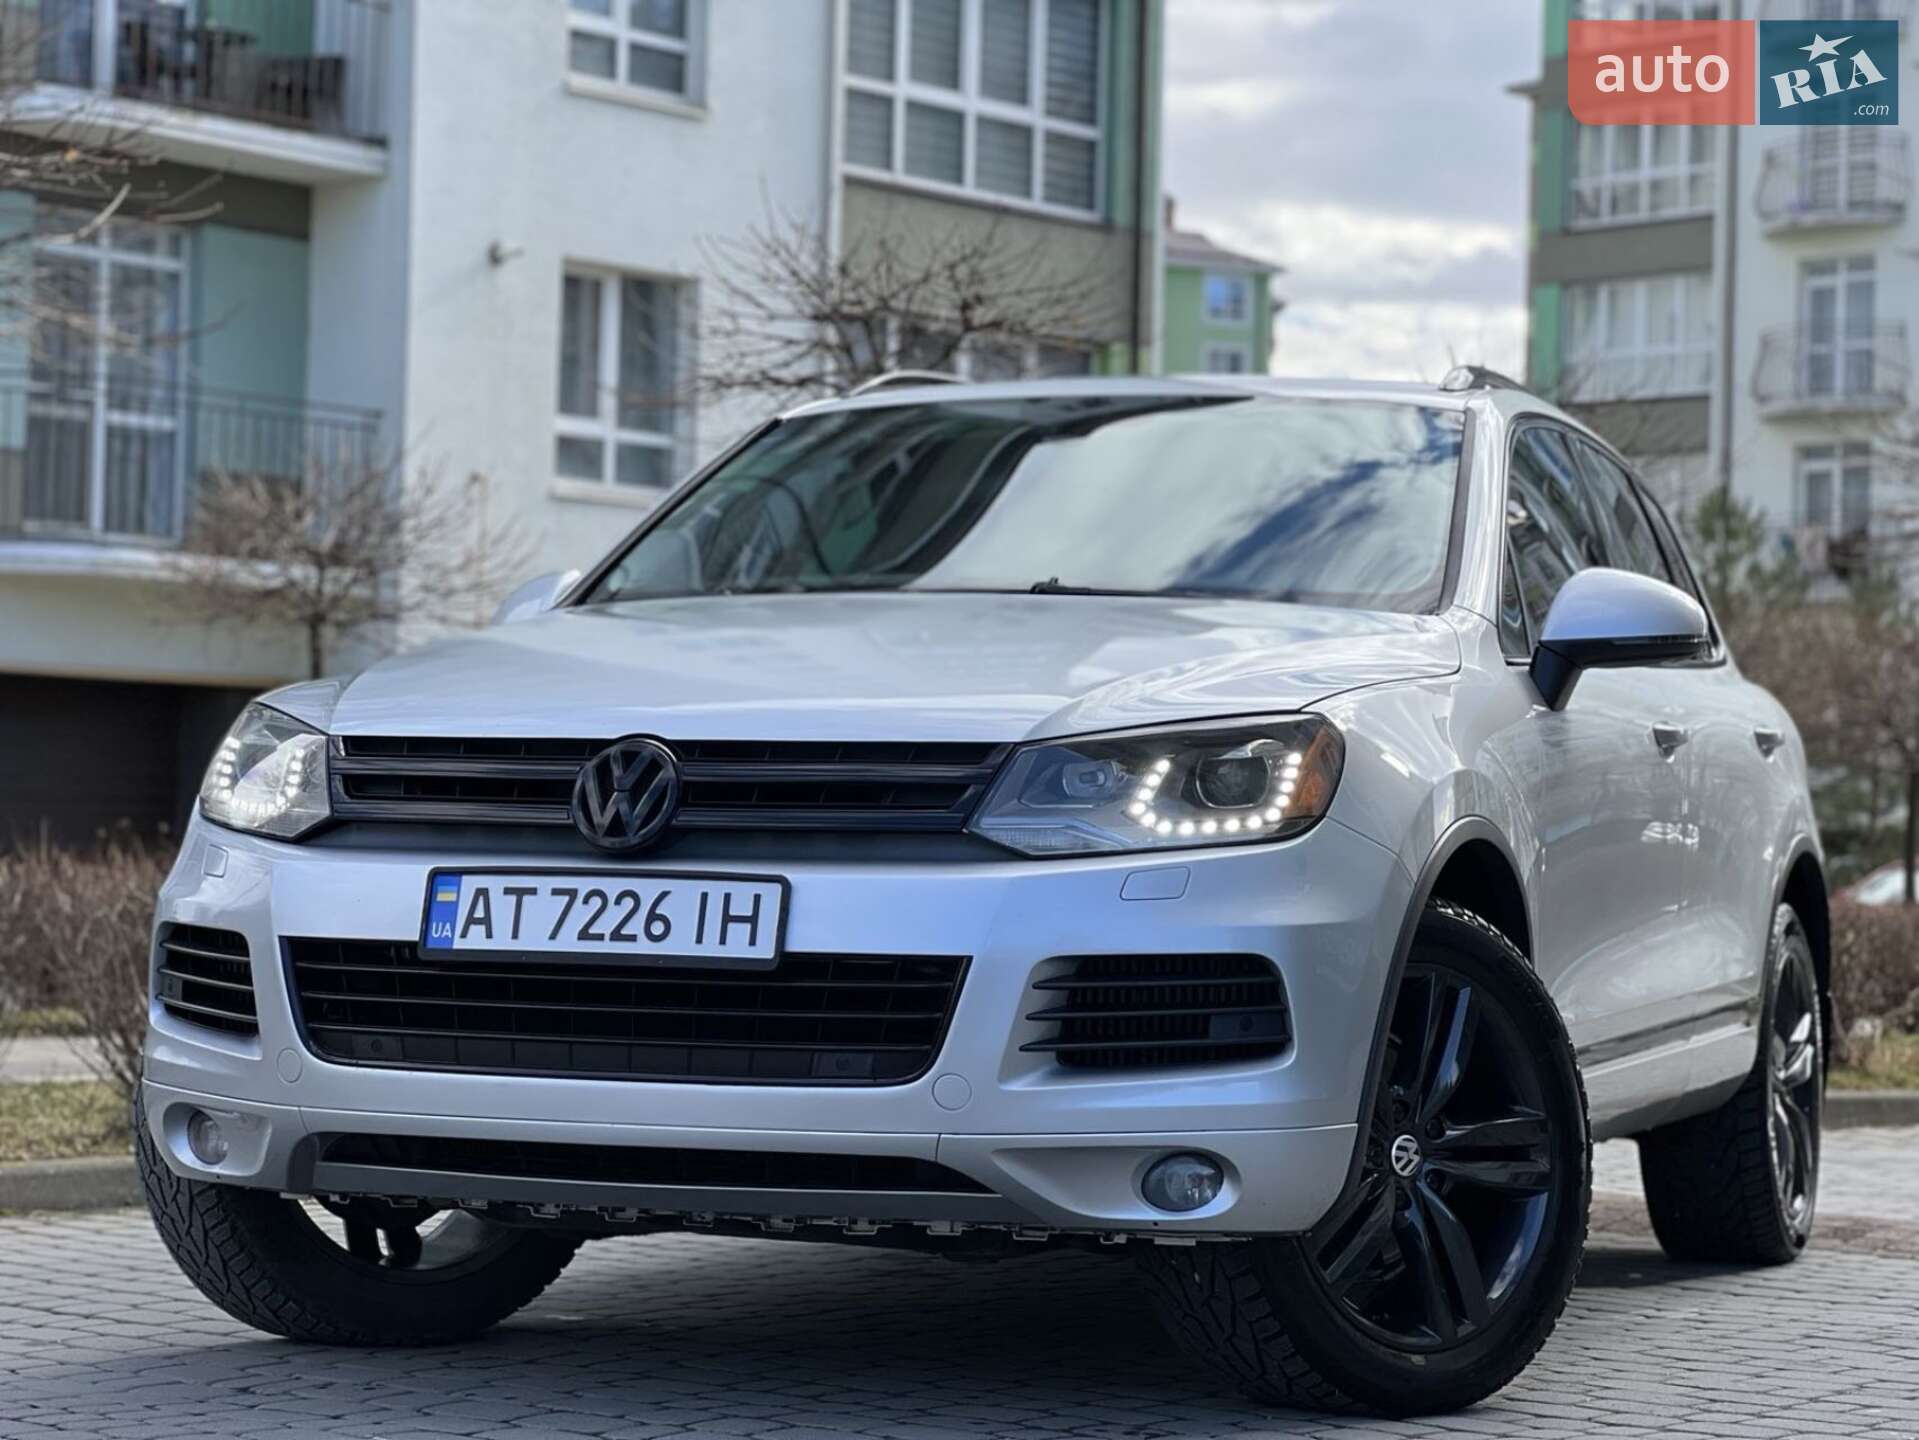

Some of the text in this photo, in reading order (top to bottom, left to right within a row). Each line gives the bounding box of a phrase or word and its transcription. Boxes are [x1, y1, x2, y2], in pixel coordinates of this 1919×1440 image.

[431, 921, 452, 938] UA
[459, 886, 762, 947] AT 7226 IH
